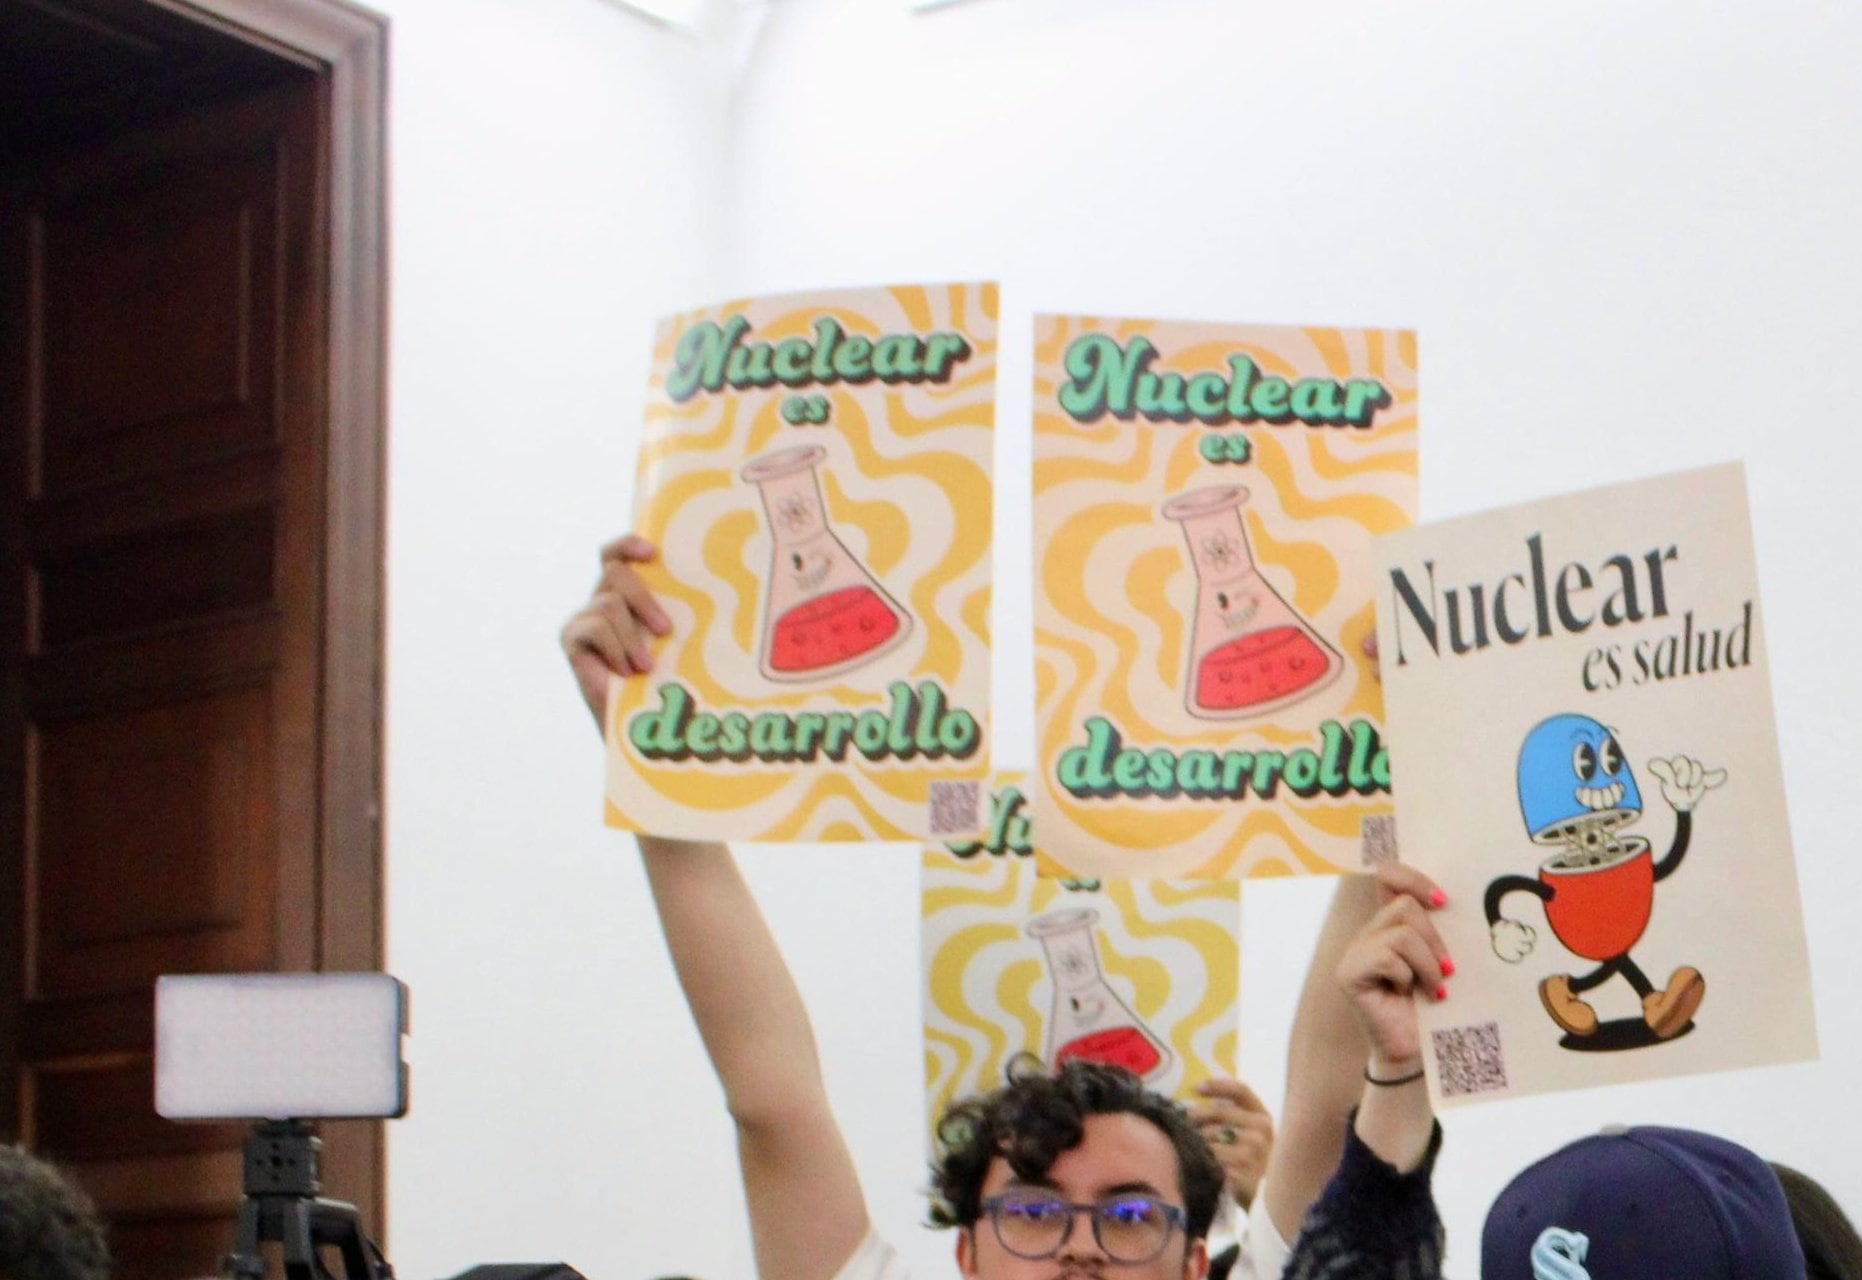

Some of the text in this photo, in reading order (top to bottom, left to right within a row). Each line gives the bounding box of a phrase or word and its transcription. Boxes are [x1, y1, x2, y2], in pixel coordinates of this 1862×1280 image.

[668, 315, 970, 402] Nuclear
[1057, 334, 1392, 427] Nuclear
[782, 393, 830, 427] es
[1199, 433, 1250, 464] es
[1388, 532, 1679, 667] Nuclear
[1582, 601, 1754, 692] es salud
[629, 680, 981, 763] desarrollo
